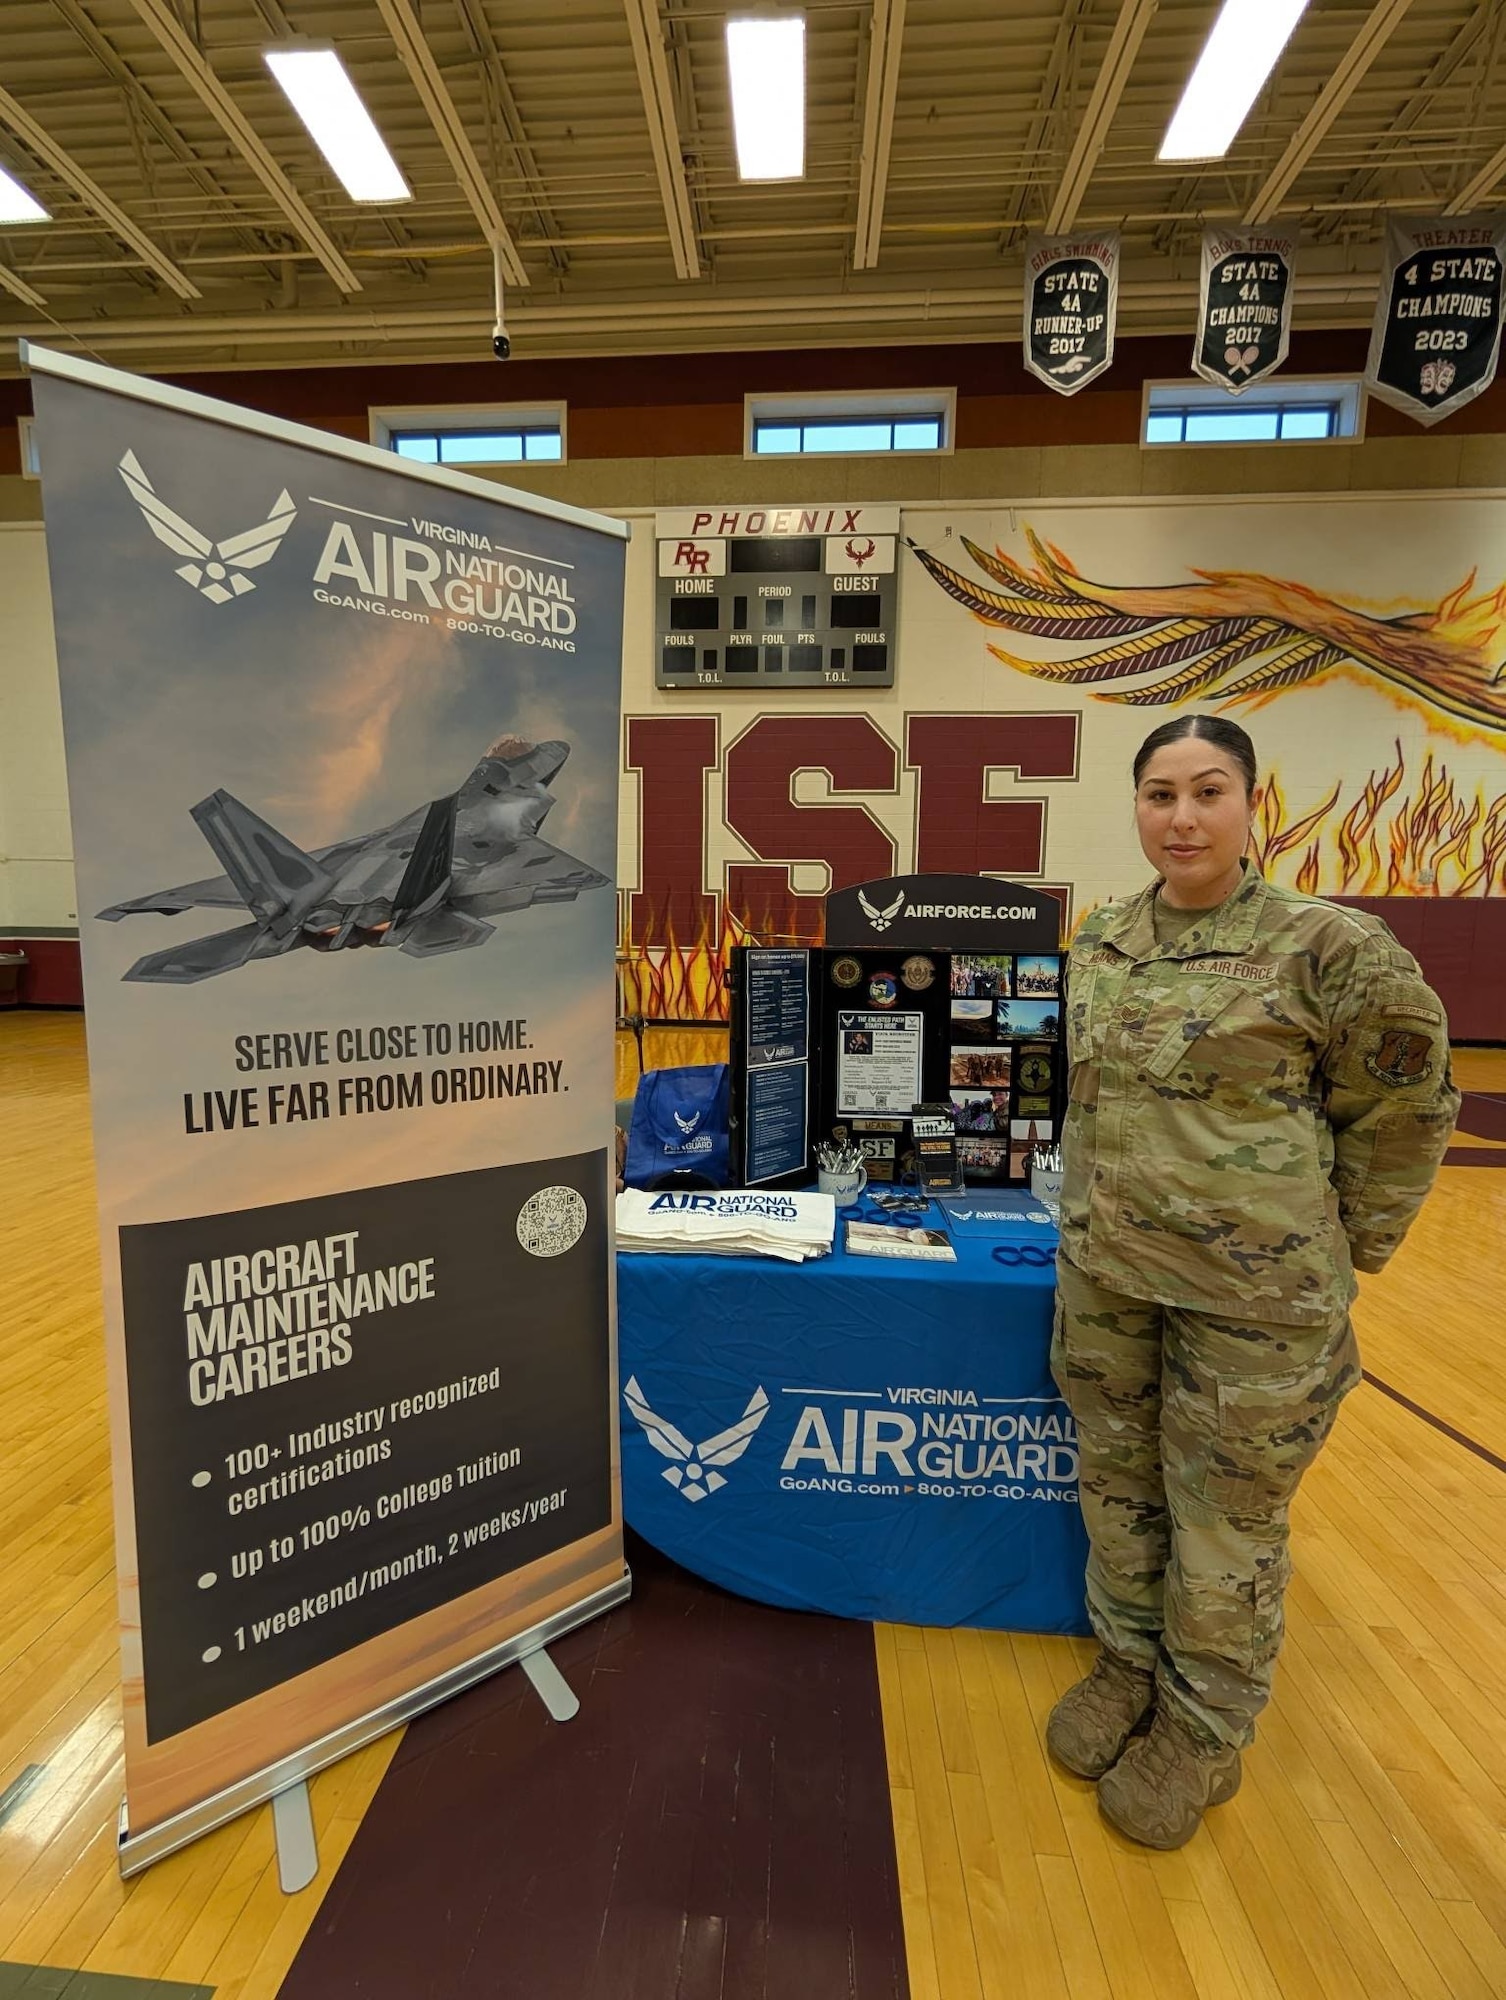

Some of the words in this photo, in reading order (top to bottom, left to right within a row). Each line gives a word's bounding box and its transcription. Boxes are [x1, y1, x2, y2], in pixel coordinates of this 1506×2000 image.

[1210, 239, 1243, 262] BOYS
[1247, 236, 1293, 259] TENNIS
[1412, 228, 1493, 248] THEATER
[1031, 250, 1062, 273] GIRLS
[1065, 244, 1115, 268] SWIMMING
[1404, 264, 1418, 285] 4
[1430, 257, 1496, 282] STATE
[1044, 272, 1100, 294] STATE
[1221, 261, 1279, 284] STATE
[1061, 293, 1081, 313] 4A
[1238, 282, 1260, 301] 4A
[1210, 306, 1279, 326] CHAMPIONS
[1396, 294, 1492, 319] CHAMPIONS
[1034, 314, 1104, 336] RUNNER-UP
[1225, 327, 1262, 345] 2017
[1049, 337, 1086, 355] 2017
[1414, 329, 1469, 351] 2023
[411, 517, 493, 552] VIRGINIA
[691, 510, 863, 535] PHOENIX
[313, 521, 443, 609] AIR
[445, 550, 576, 602] NATIONAL
[675, 579, 714, 594] HOME
[833, 576, 879, 592] GUEST
[758, 586, 792, 597] PERIOD
[444, 579, 577, 635] GUARD
[313, 588, 430, 624] GoANG.com
[446, 617, 576, 653] 800-TO-GO-ANG
[665, 635, 694, 646] FOULS
[730, 634, 752, 645] PLYR
[762, 634, 785, 644] FOUL
[797, 634, 815, 643] PTS
[855, 633, 886, 643] FOULS
[697, 673, 723, 683] T.O.L.
[824, 672, 850, 682] T.O.L.
[904, 905, 1037, 920] AIRFORCE.COM
[1186, 961, 1208, 972] U.S.
[1209, 961, 1231, 974] AIR
[1232, 965, 1274, 980] FORCE
[235, 1031, 329, 1072] SERVE
[336, 1025, 418, 1063] CLOSE
[422, 1023, 452, 1056] TO
[458, 1019, 534, 1053] HOME.
[184, 1087, 259, 1134] LIVE
[268, 1081, 330, 1125] FAR
[339, 1072, 423, 1116] FROM
[431, 1060, 569, 1105] ORDINARY.
[861, 1140, 893, 1157] SF
[648, 1193, 718, 1212] AIR
[719, 1196, 797, 1206] NATIONAL
[717, 1205, 797, 1218] GUARD
[183, 1231, 359, 1311] AIRCRAFT
[186, 1257, 436, 1360] MAINTENANCE
[189, 1323, 353, 1407] CAREERS
[886, 1387, 978, 1407] VIRGINIA
[225, 1443, 283, 1479] 100+
[289, 1405, 385, 1459] Industry
[390, 1366, 500, 1422] recognized
[780, 1406, 915, 1476] AIR
[922, 1412, 1078, 1443] NATIONAL
[917, 1441, 1080, 1483] GUARD
[228, 1438, 392, 1516] certifications
[780, 1476, 899, 1496] GoANG.com
[917, 1482, 1079, 1503] 800-TO-GO-ANG
[231, 1548, 264, 1580] Up
[269, 1535, 295, 1563] to
[300, 1505, 371, 1552] 100%
[376, 1474, 453, 1520] College
[457, 1447, 521, 1490] Tuition
[234, 1626, 246, 1652] 1
[252, 1544, 444, 1643] weekend/month,
[448, 1533, 460, 1558] 2
[463, 1487, 568, 1549] weeks/year
